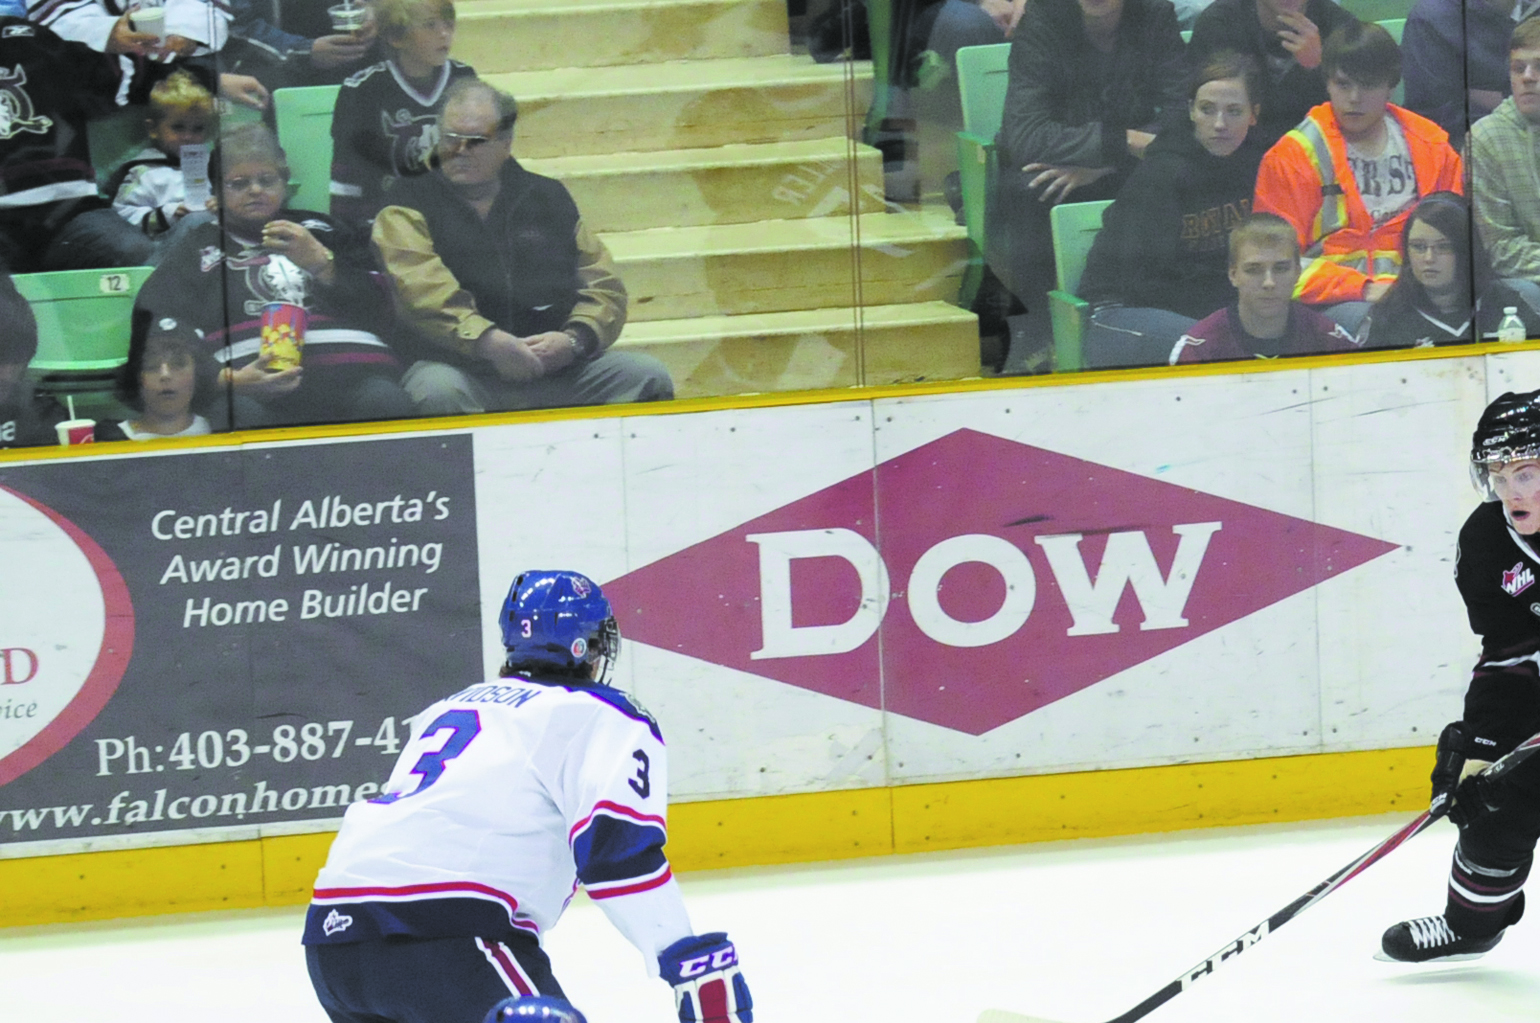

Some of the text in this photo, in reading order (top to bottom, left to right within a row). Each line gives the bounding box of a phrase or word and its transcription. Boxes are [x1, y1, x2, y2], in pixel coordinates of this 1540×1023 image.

[107, 275, 121, 291] 12
[151, 490, 450, 540] Central Alberta's
[159, 537, 443, 585] Award Winning
[1503, 567, 1535, 596] WHL
[183, 581, 428, 628] Home Builder
[746, 521, 1222, 660] DOW
[520, 619, 532, 638] 3
[0, 698, 38, 719] ice
[367, 708, 482, 805] 3
[628, 748, 650, 800] 3
[679, 944, 738, 978] CC
